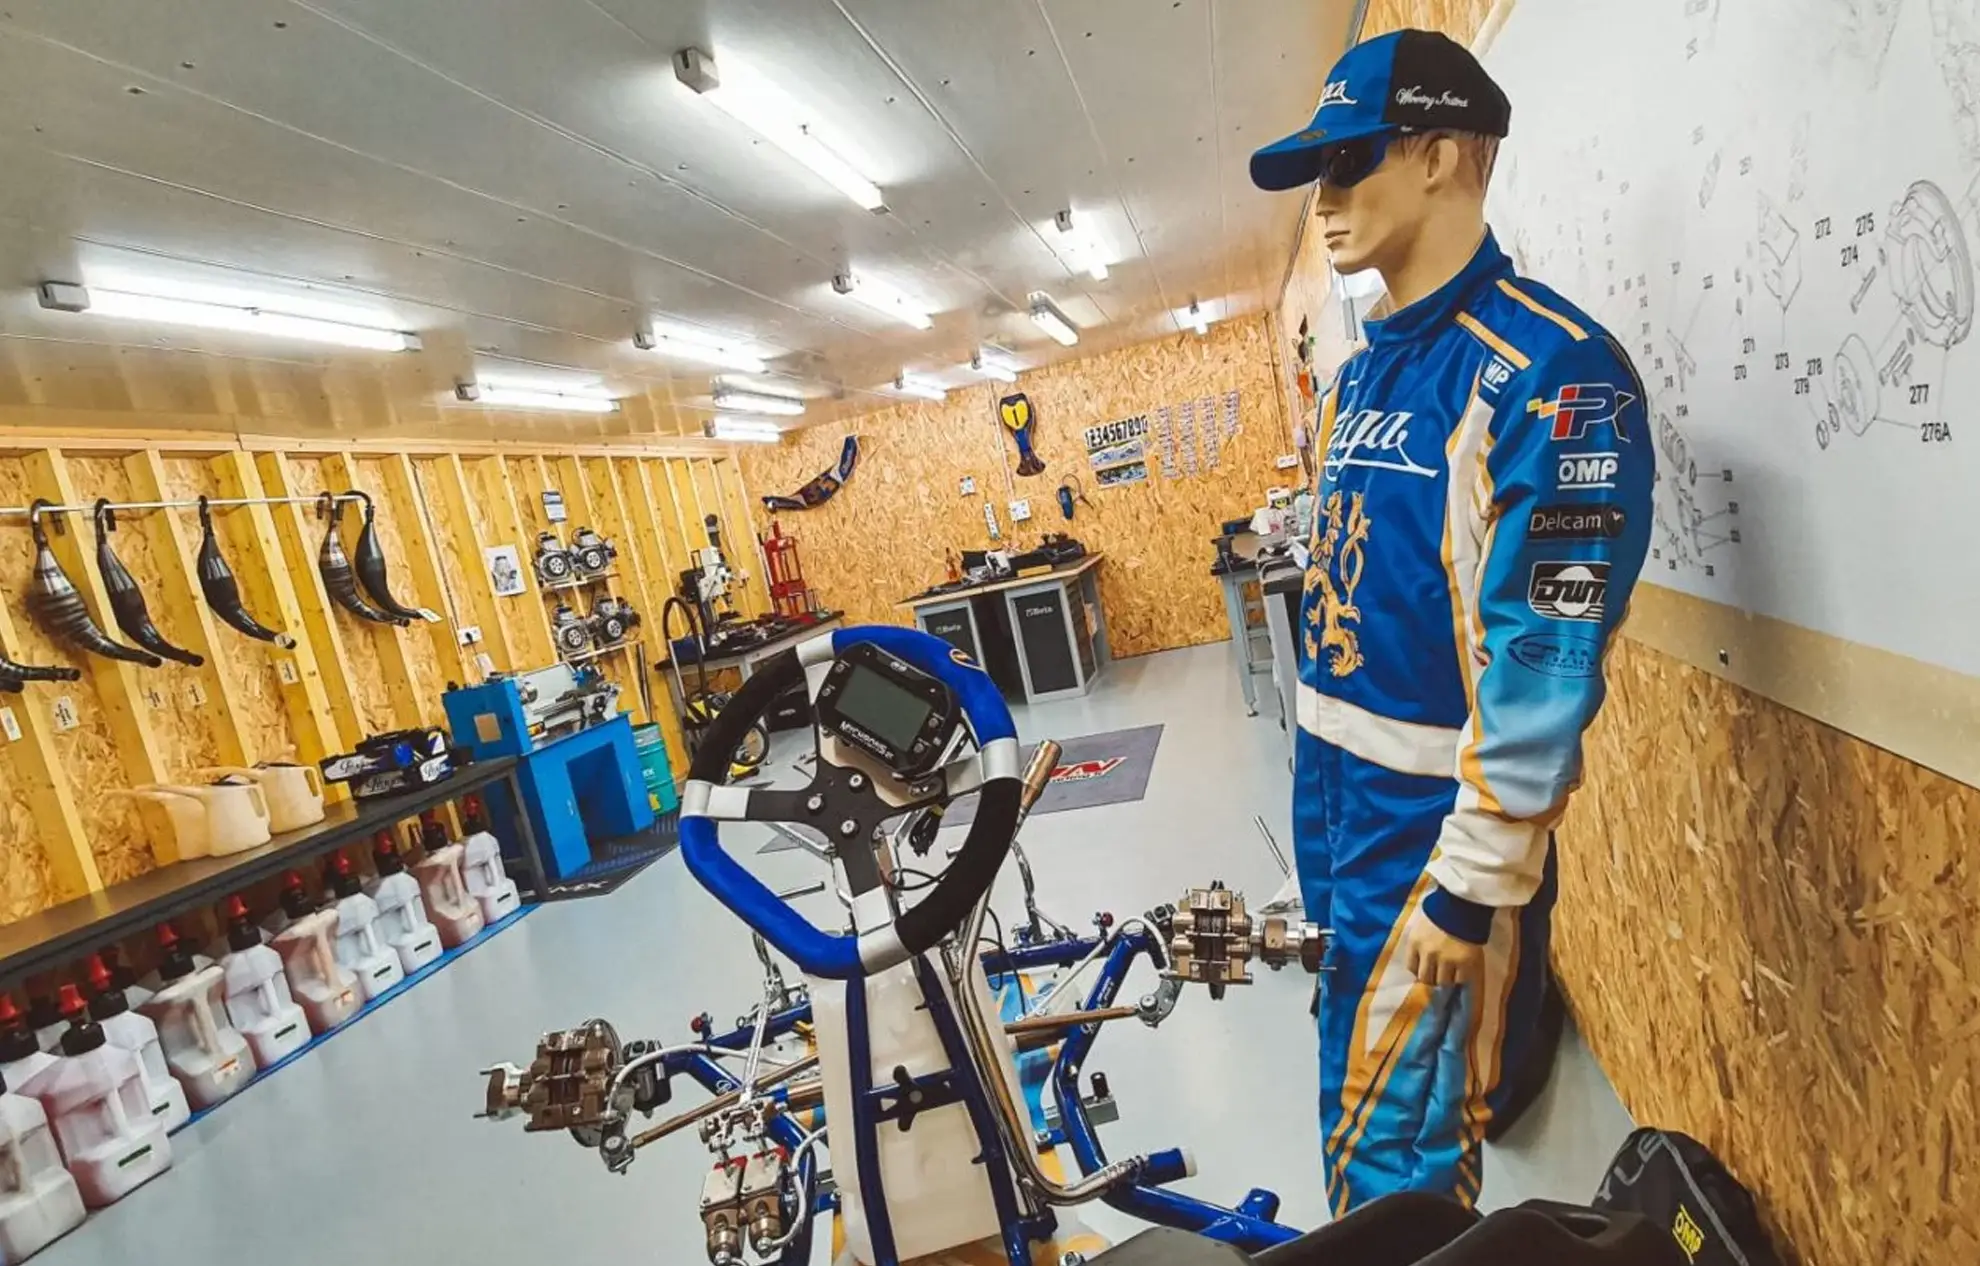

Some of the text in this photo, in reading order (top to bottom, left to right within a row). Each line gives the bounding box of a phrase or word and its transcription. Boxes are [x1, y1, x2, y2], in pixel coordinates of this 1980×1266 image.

[1815, 216, 1831, 239] 272
[1856, 212, 1874, 237] 275
[1841, 244, 1859, 267] 274
[1775, 352, 1789, 370] 273
[1807, 357, 1823, 376] 278
[1795, 377, 1809, 394] 279
[1909, 384, 1929, 404] 277
[1921, 422, 1952, 441] 276A
[1558, 457, 1618, 484] OMP
[1529, 509, 1601, 532] Delcam
[1675, 1211, 1702, 1255] OMP
